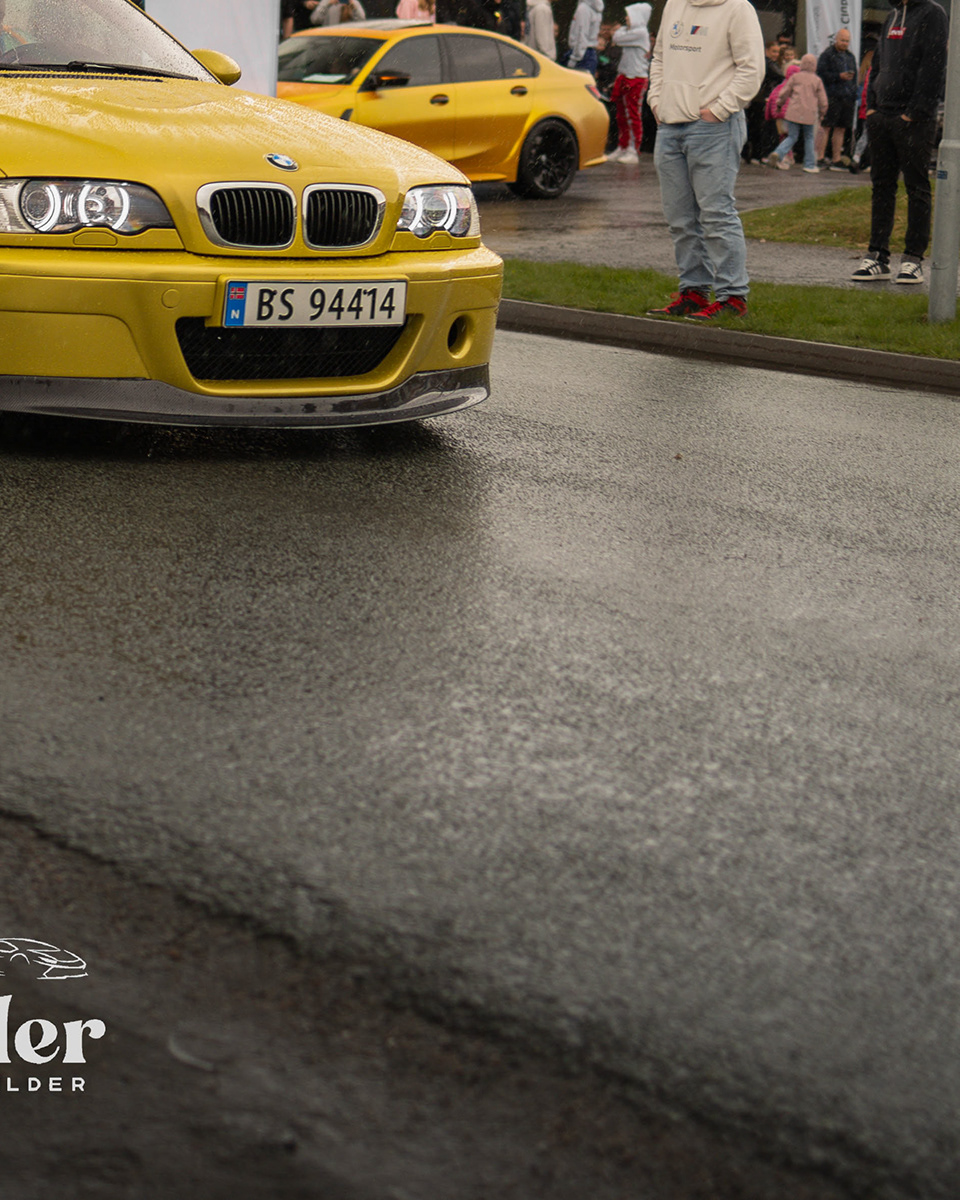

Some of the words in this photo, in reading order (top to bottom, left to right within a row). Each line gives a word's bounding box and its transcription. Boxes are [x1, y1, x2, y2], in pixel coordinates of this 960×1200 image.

[230, 309, 240, 320] N
[256, 288, 295, 321] BS
[309, 287, 396, 321] 94414
